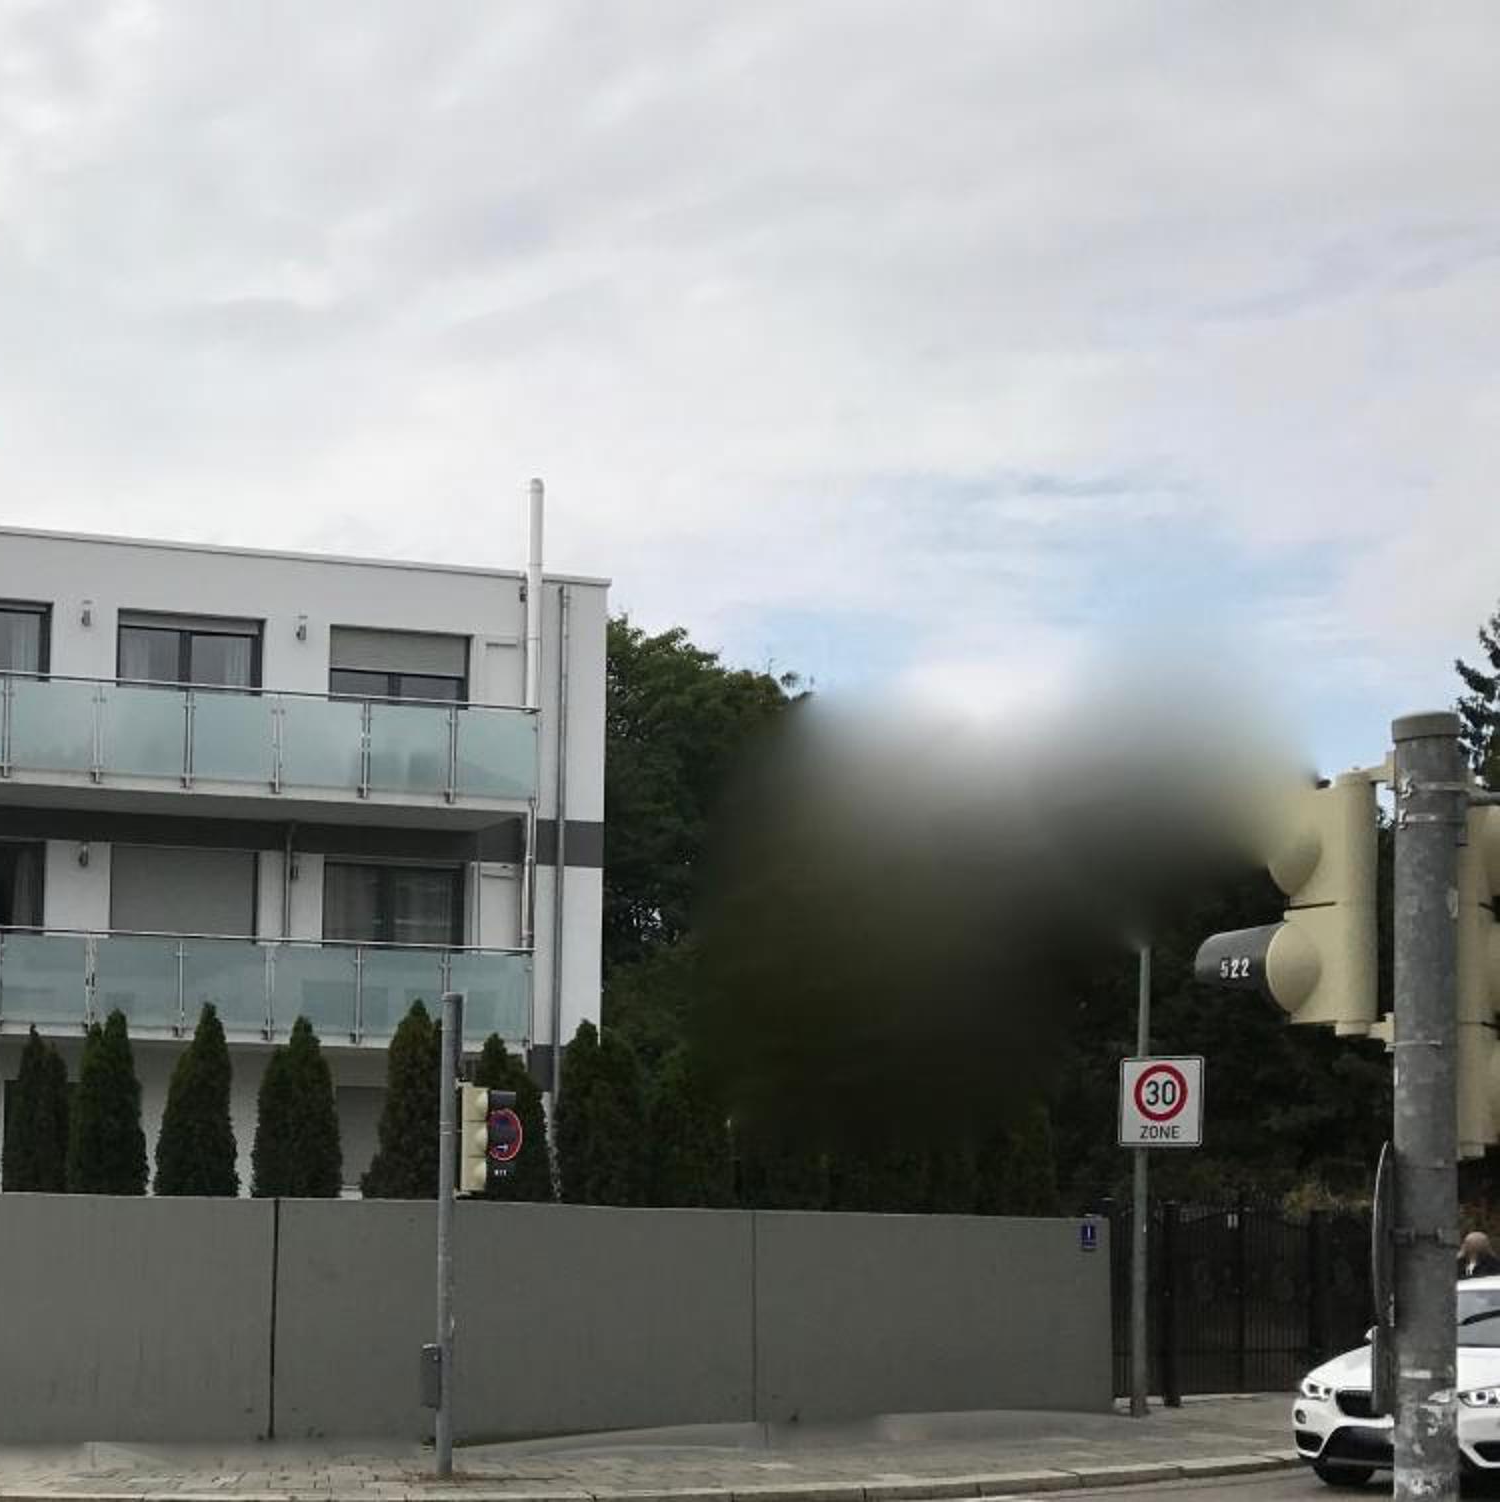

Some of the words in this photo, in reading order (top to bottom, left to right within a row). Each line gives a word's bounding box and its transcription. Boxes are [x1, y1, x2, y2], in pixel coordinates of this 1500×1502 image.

[1219, 957, 1250, 979] 522
[1146, 1080, 1176, 1106] 30
[1140, 1125, 1181, 1139] ZONE
